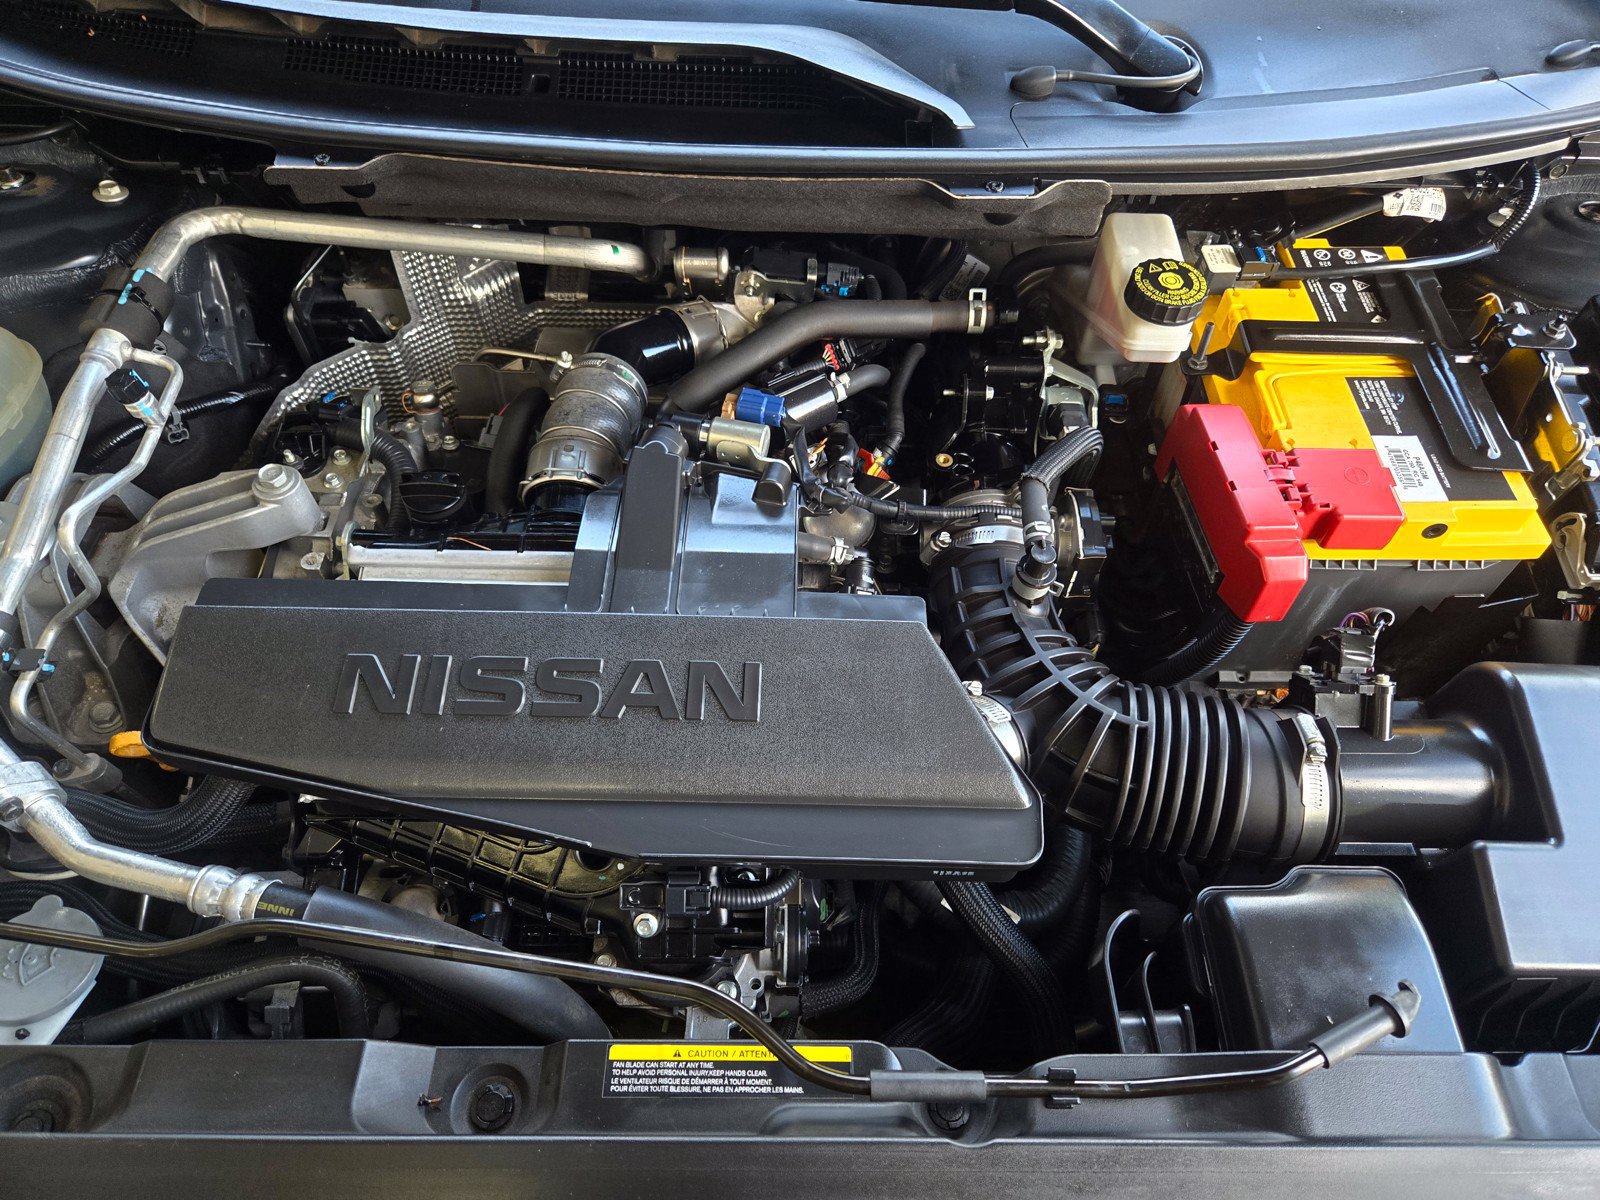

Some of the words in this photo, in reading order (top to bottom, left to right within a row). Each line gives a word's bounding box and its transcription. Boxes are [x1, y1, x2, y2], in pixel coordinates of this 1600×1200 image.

[1413, 457, 1429, 479] P48AGM
[1440, 472, 1451, 488] BATTERY
[333, 653, 763, 723] NISSAN
